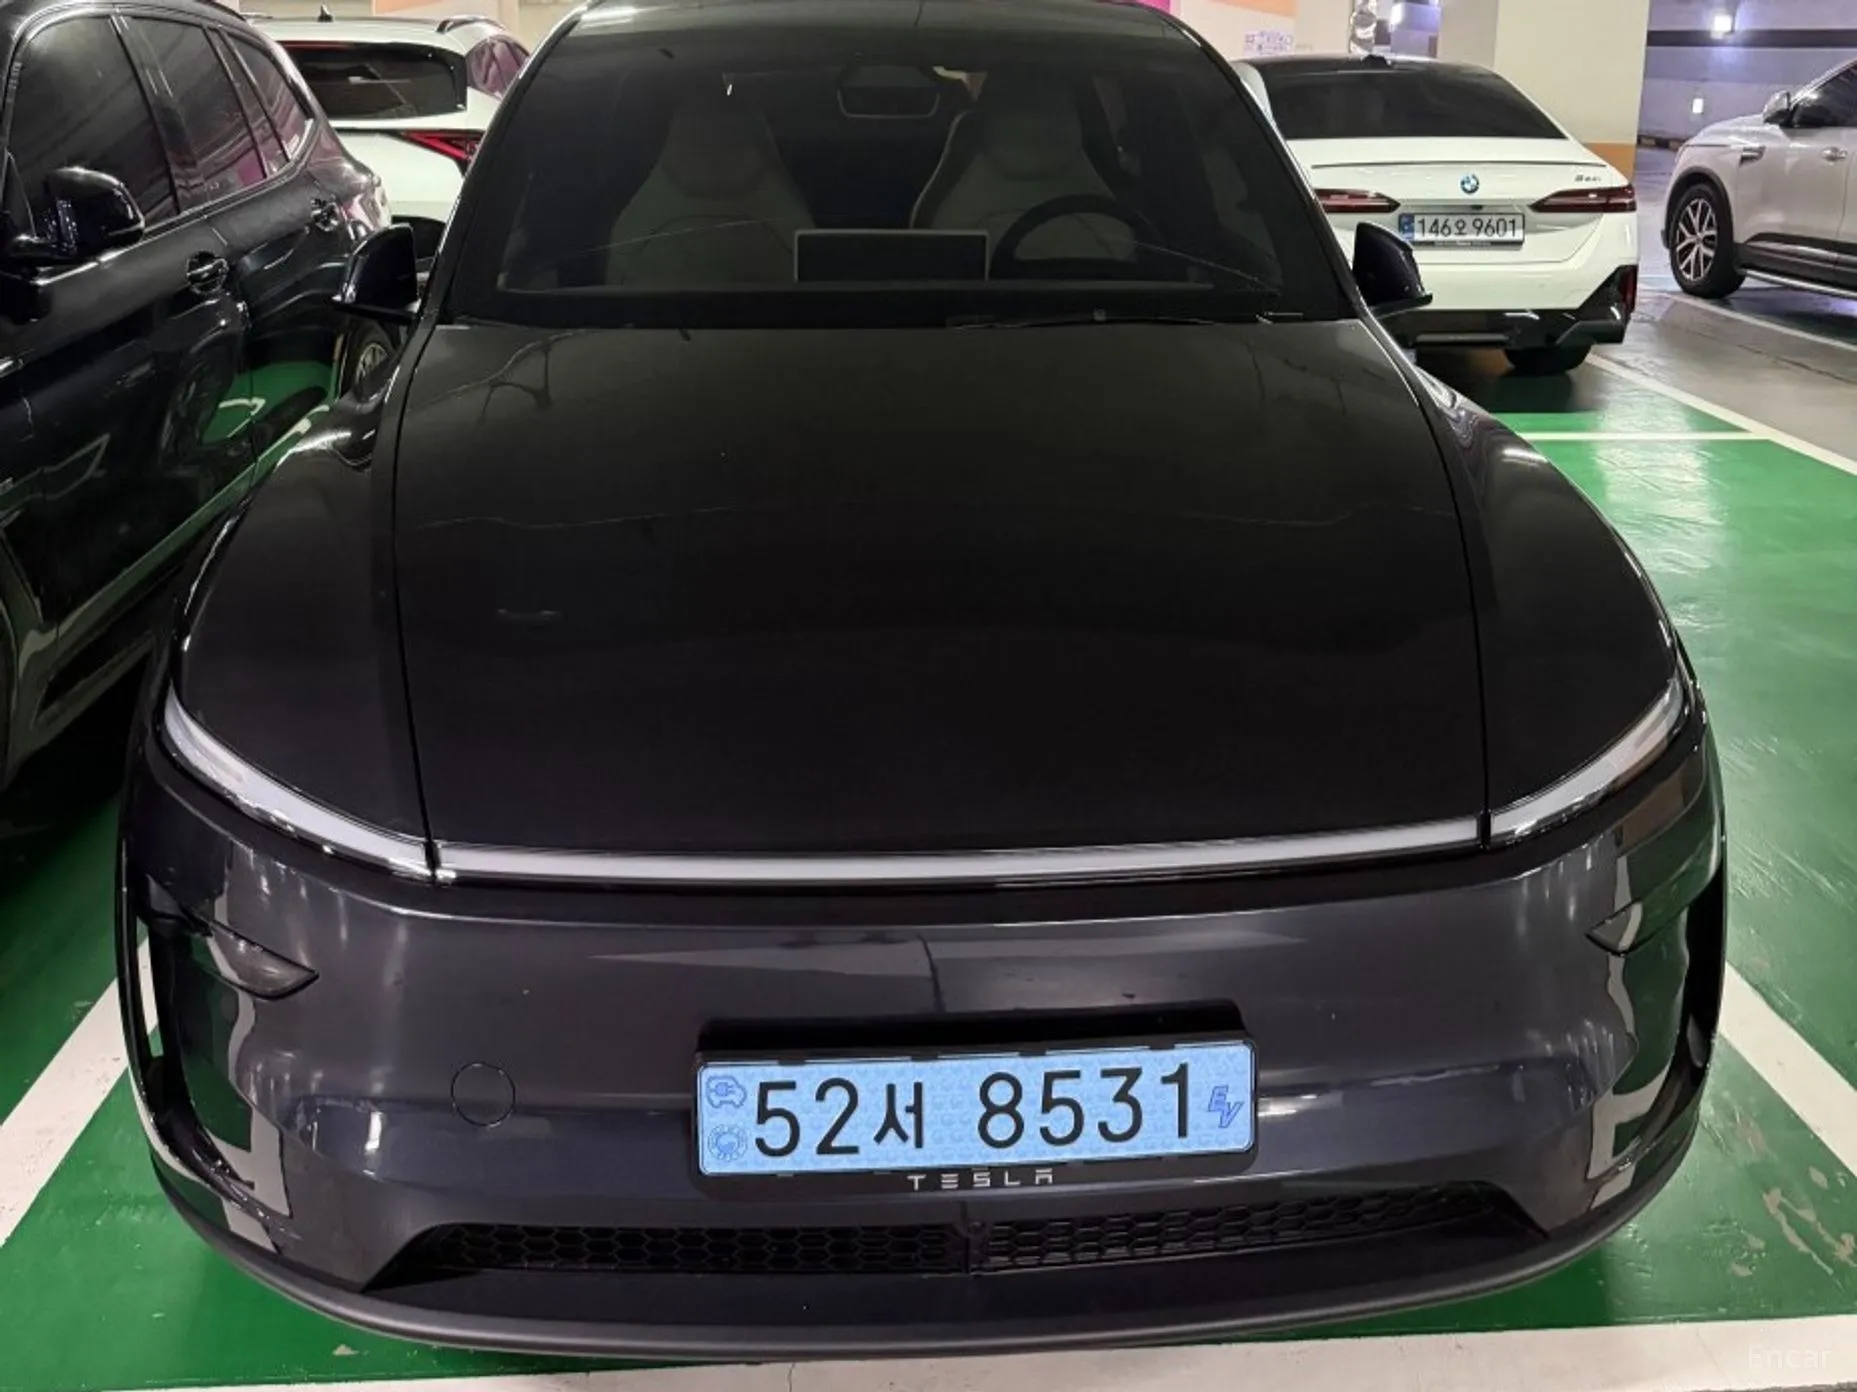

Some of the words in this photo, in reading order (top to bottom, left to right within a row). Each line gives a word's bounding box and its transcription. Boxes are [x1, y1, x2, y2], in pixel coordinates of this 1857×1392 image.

[1417, 218, 1467, 237] 146오
[1472, 218, 1516, 237] 9601
[754, 1076, 925, 1158] 52서
[977, 1062, 1190, 1150] 8531
[1207, 1084, 1245, 1129] EV
[906, 1167, 1053, 1191] TESLA
